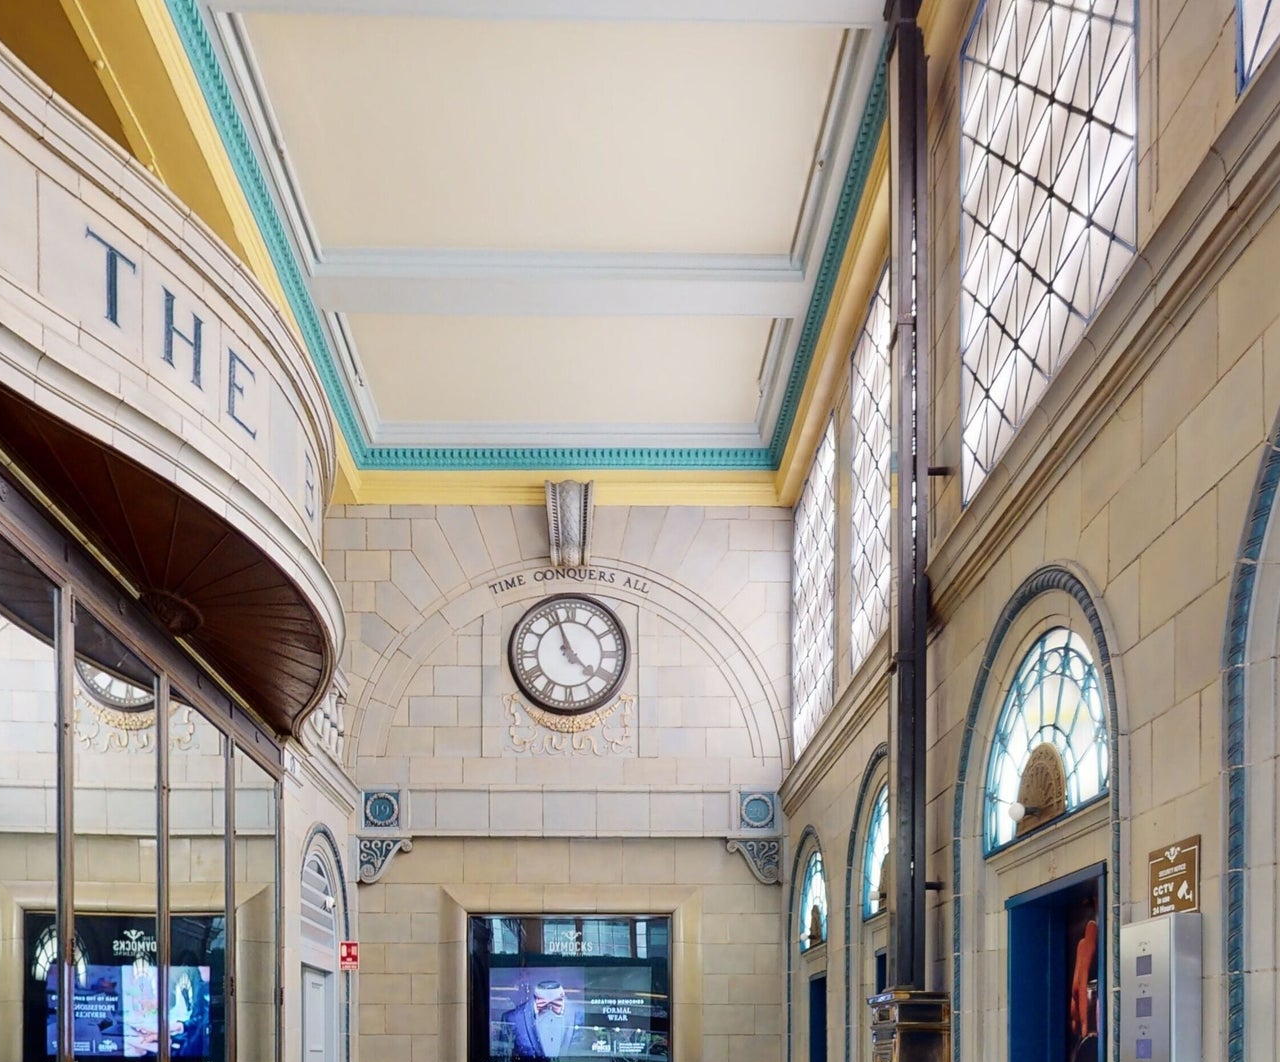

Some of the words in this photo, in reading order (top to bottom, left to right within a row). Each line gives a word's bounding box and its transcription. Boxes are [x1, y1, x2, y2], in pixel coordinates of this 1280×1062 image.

[85, 226, 257, 440] THE
[489, 574, 526, 595] TIME
[534, 567, 616, 583] CONQUERS
[624, 577, 650, 594] ALL
[375, 804, 390, 816] 19
[1153, 882, 1174, 896] CCTV
[1152, 906, 1160, 915] 24
[549, 941, 593, 952] DYMOCKS
